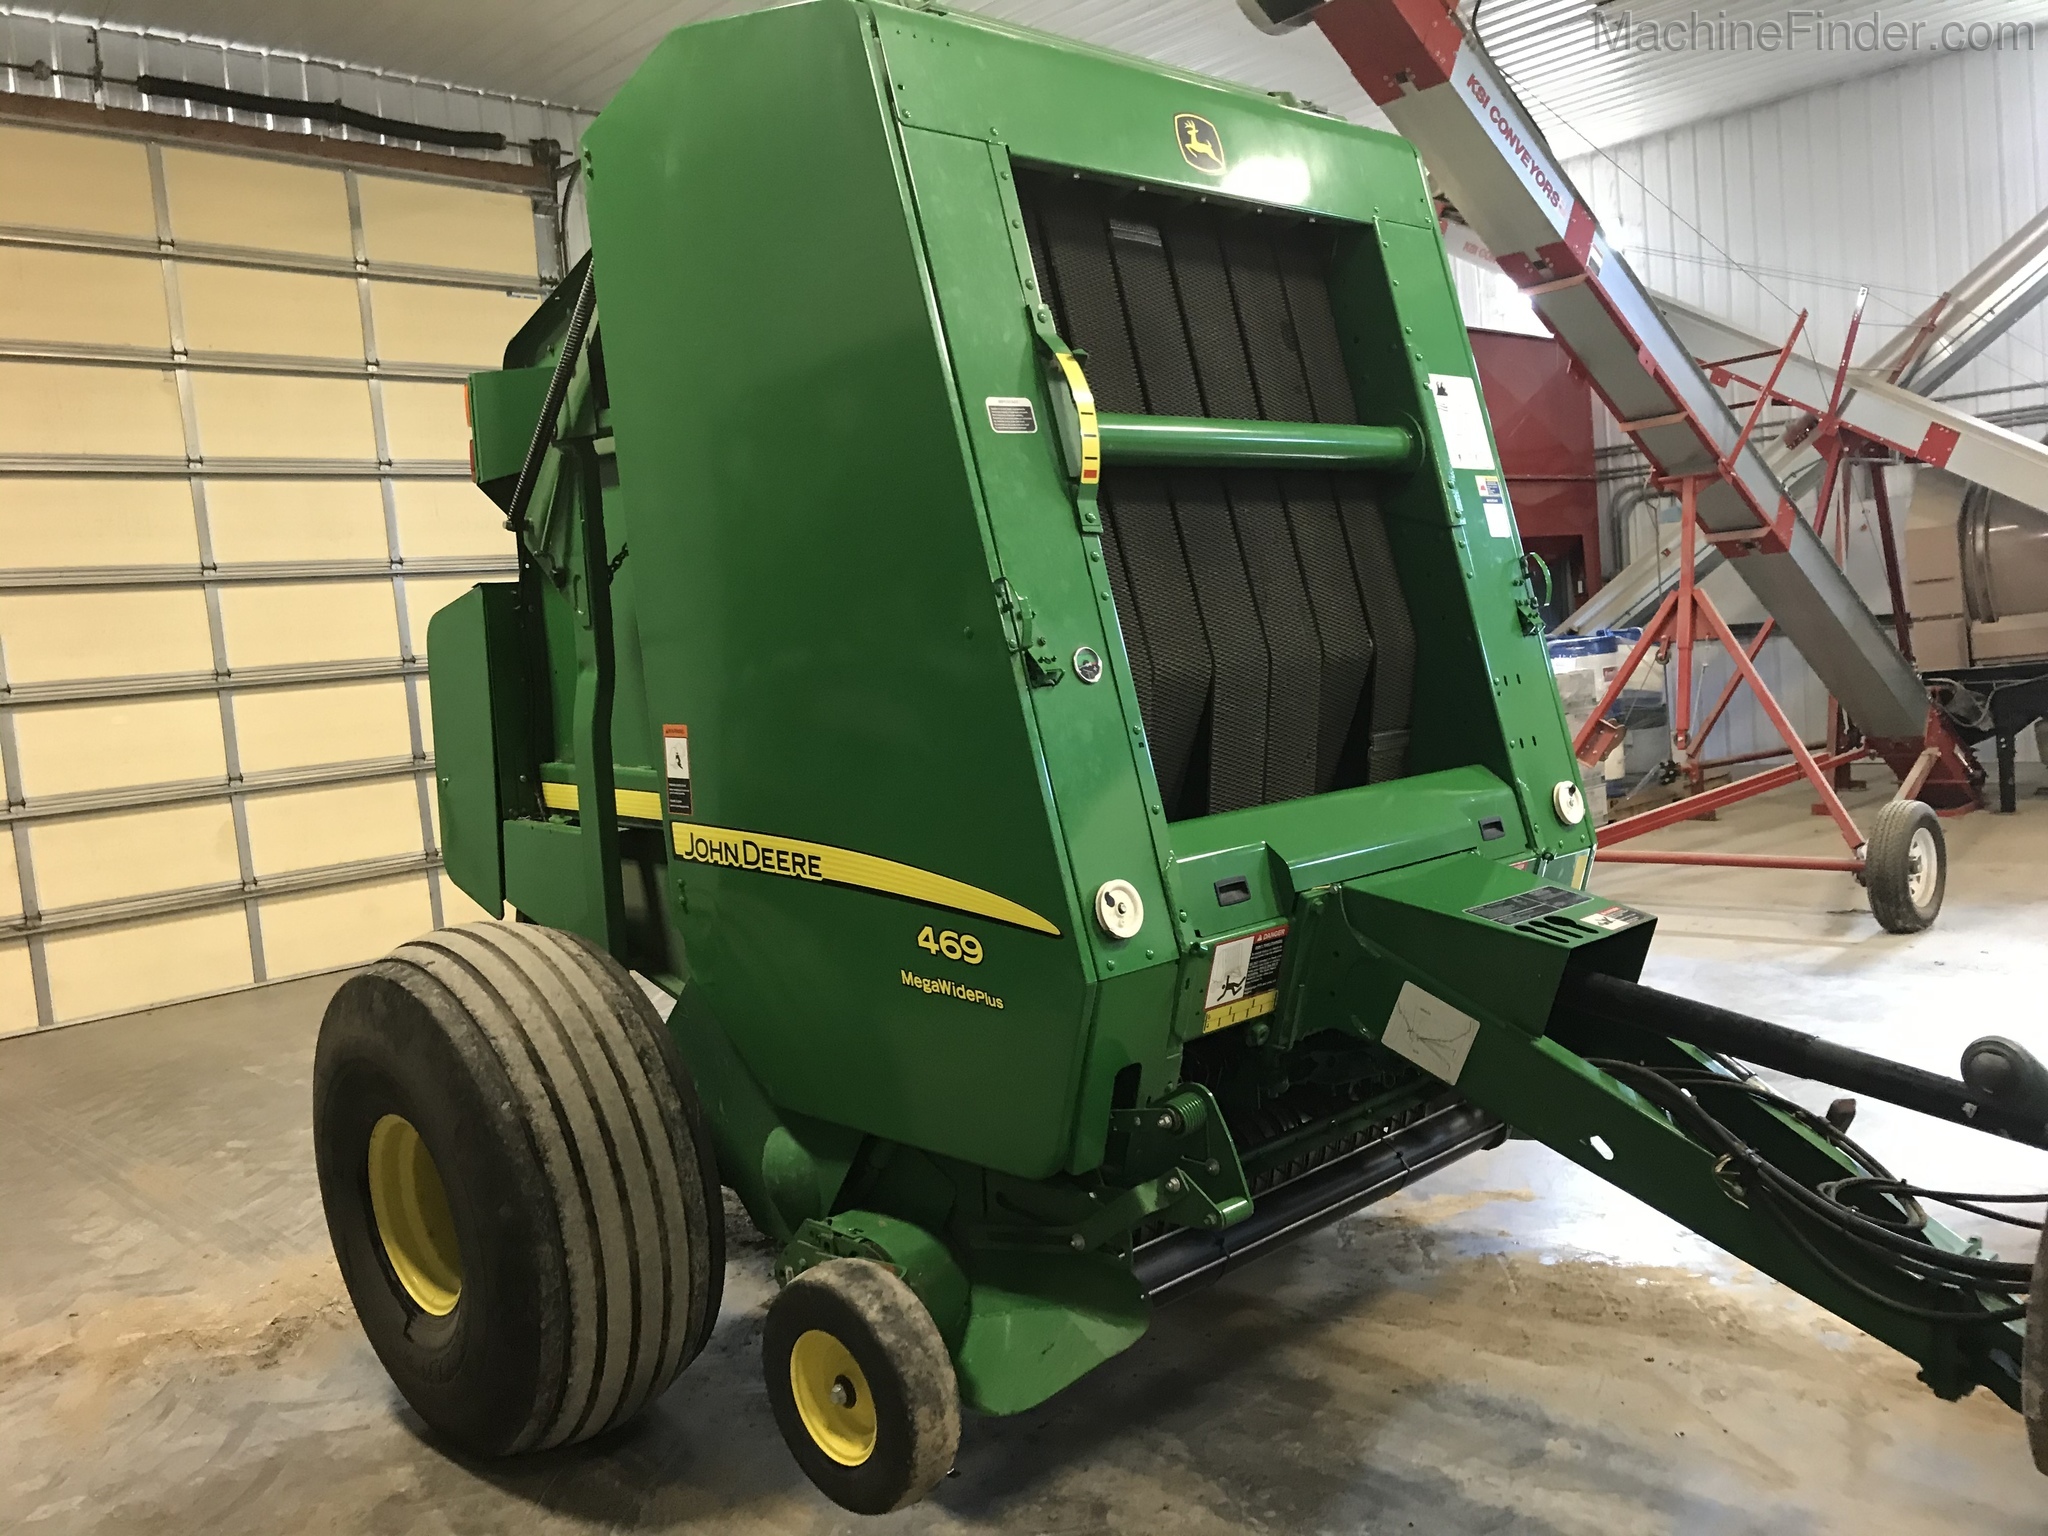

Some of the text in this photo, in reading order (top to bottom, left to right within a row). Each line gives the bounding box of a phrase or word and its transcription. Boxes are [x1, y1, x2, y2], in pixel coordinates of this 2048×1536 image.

[1466, 73, 1560, 208] KSI CONVEYORS
[684, 832, 823, 878] JOHN DEERE
[916, 924, 984, 965] 469
[900, 968, 1004, 1009] MegaWidePlus
